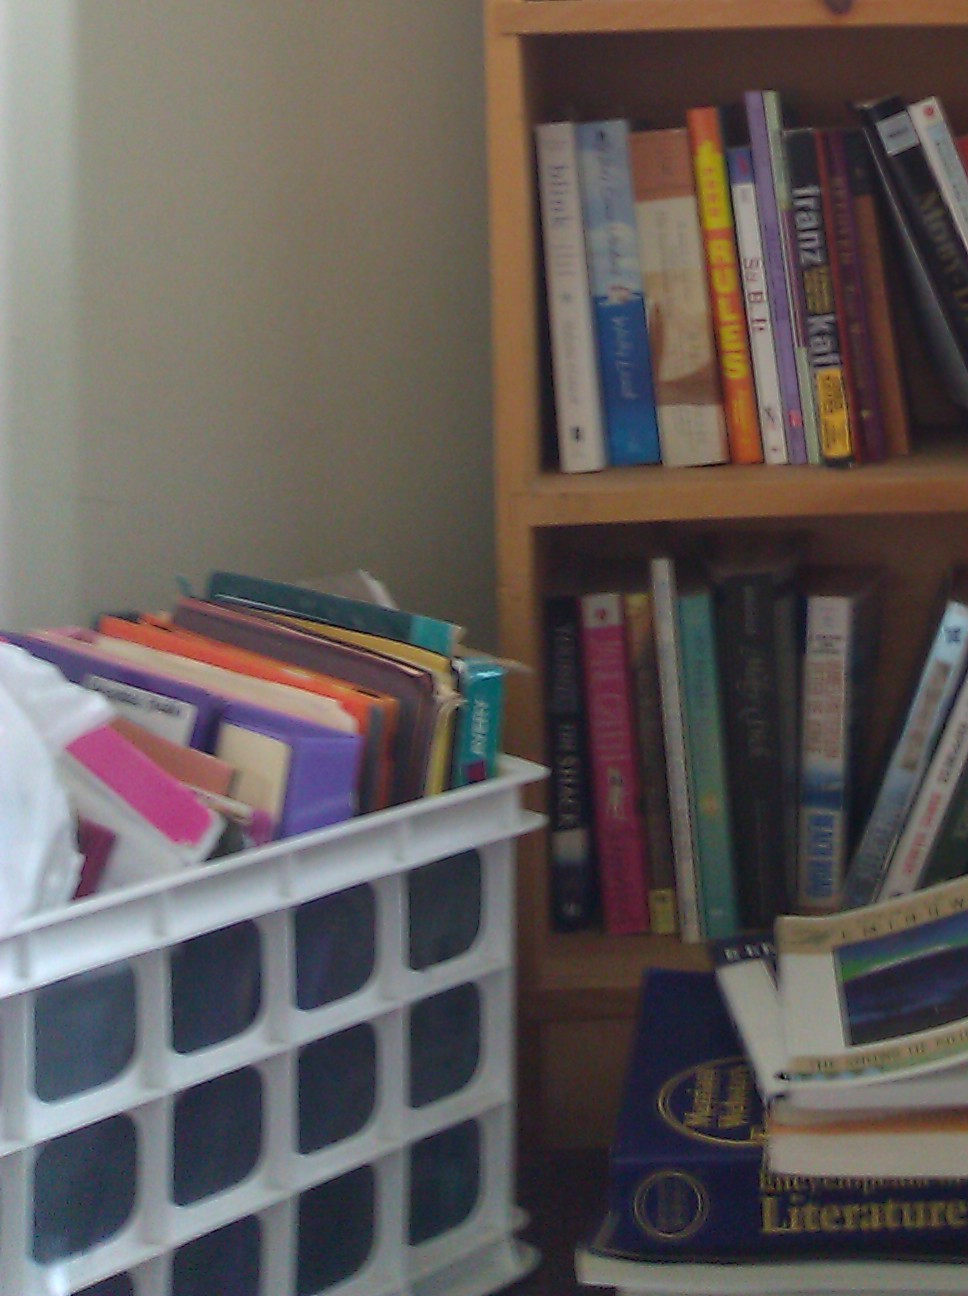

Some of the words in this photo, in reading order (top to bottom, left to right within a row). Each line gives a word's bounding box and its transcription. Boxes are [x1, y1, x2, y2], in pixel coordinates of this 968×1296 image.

[790, 183, 827, 267] franz
[706, 238, 748, 380] RULES
[761, 1195, 968, 1233] Literature
